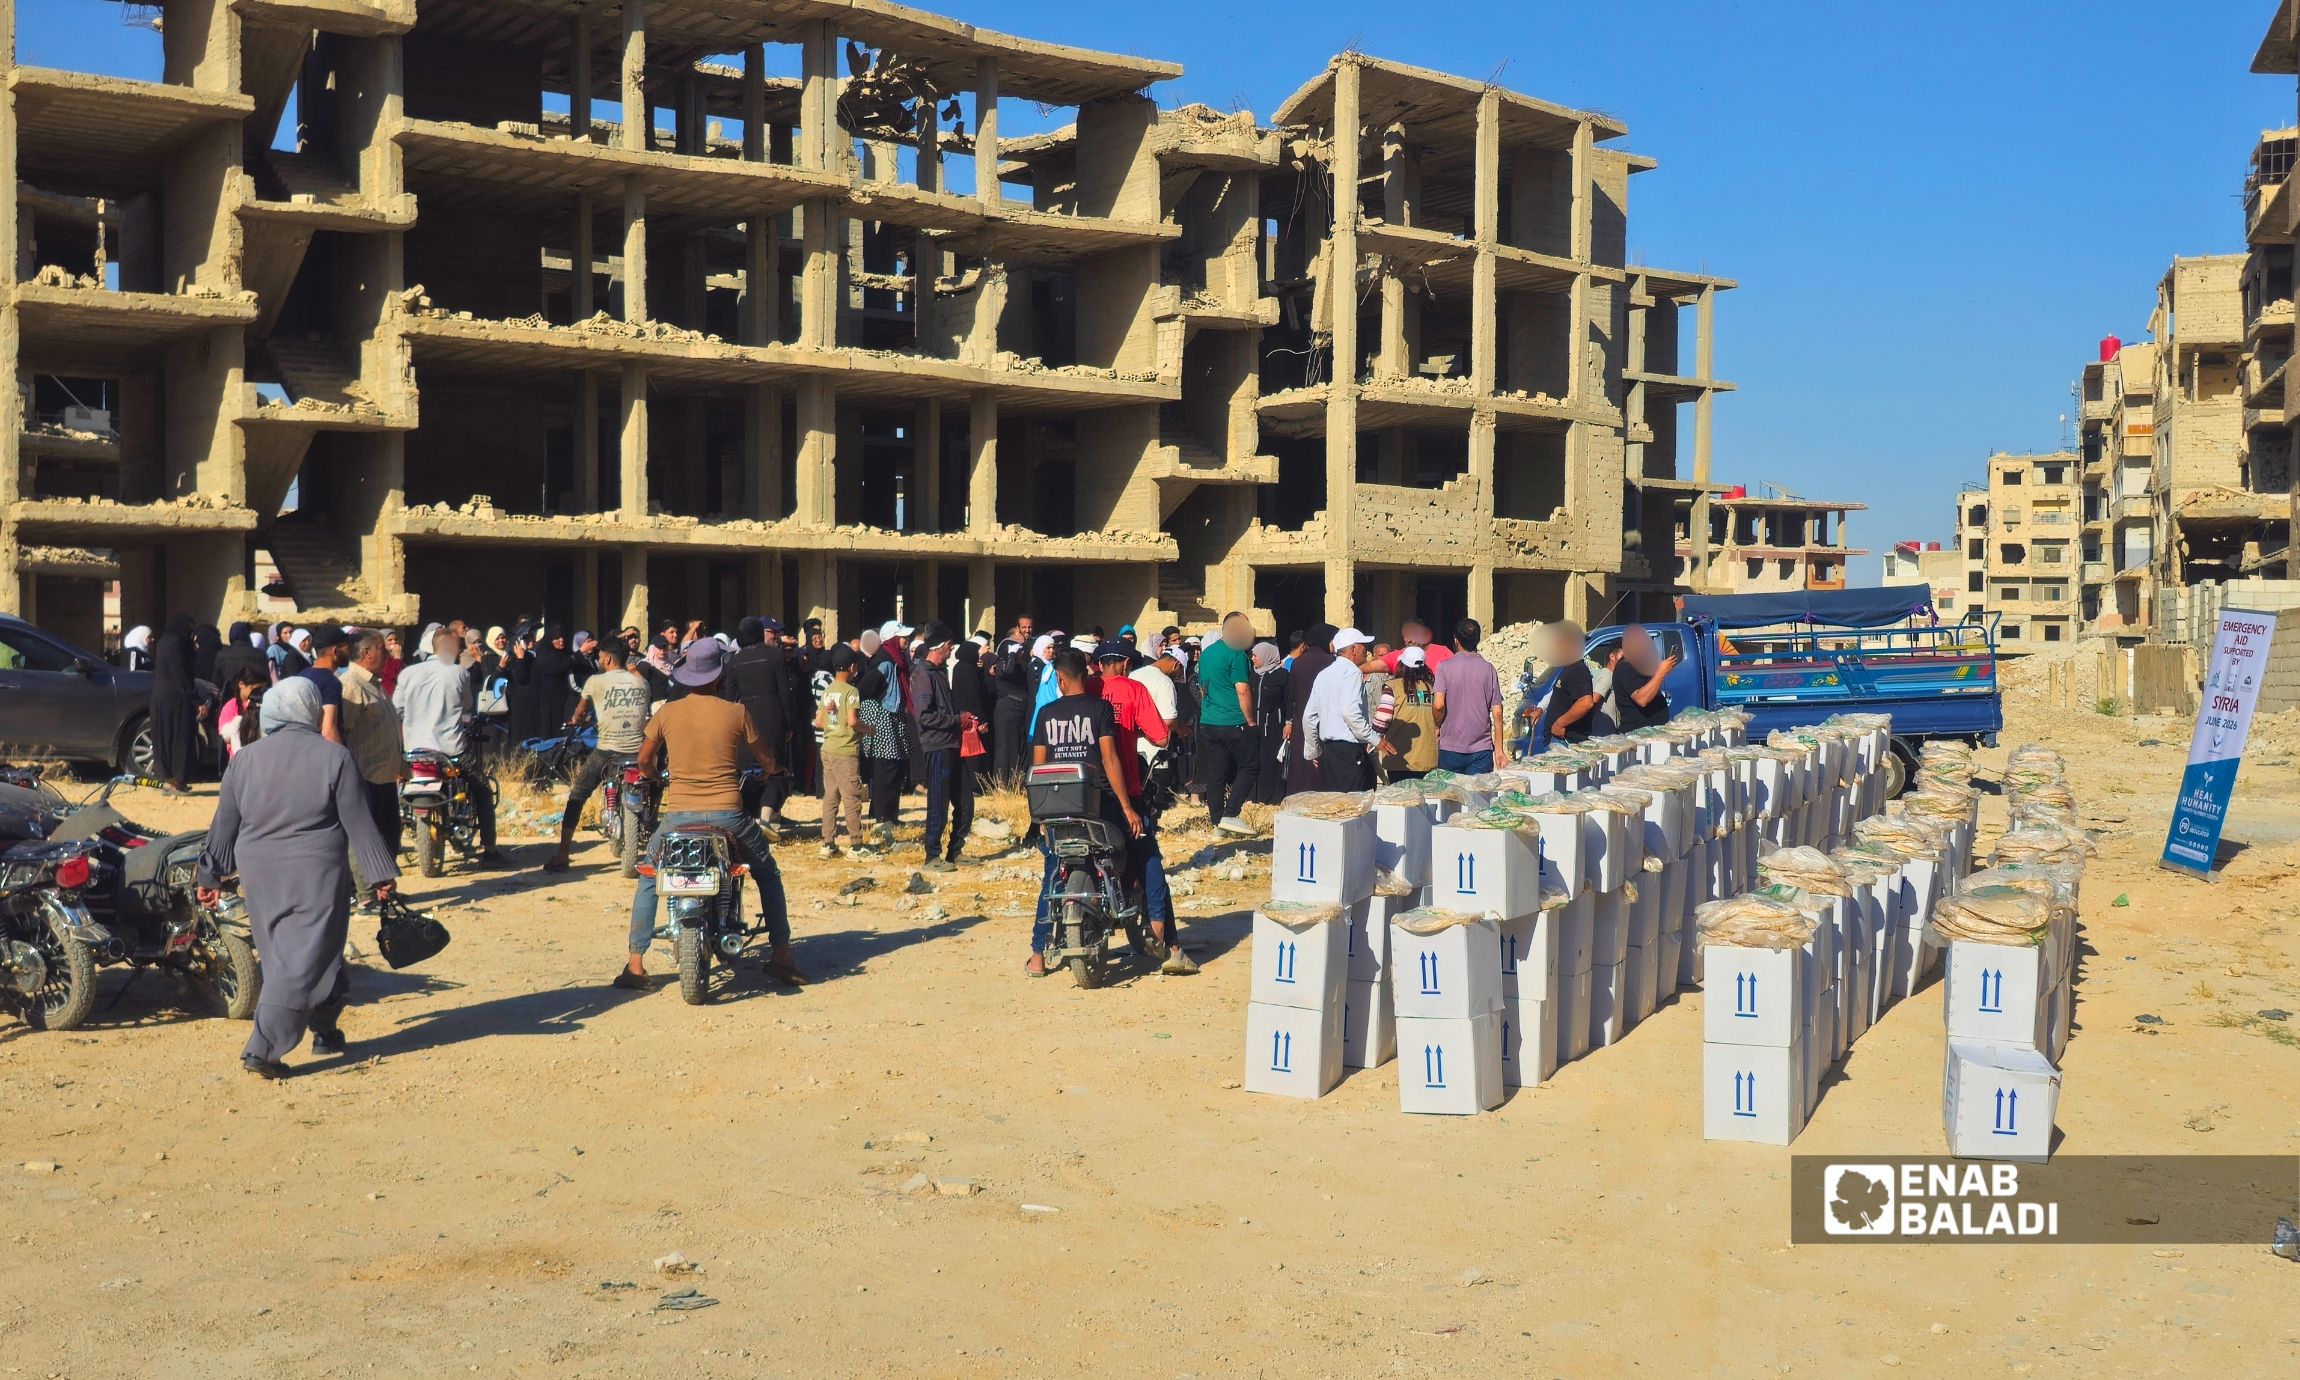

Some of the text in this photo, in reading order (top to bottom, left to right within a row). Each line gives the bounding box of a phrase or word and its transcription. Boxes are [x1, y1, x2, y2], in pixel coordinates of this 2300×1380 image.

[2222, 621, 2267, 635] EMERGENCY
[2234, 634, 2248, 645] AID
[2223, 646, 2254, 657] SUPPORTED
[604, 686, 646, 700] NEVER
[603, 697, 645, 711] ALONE
[2212, 695, 2239, 713] SYRIA
[1045, 714, 1095, 746] UTNA
[2205, 716, 2238, 730] JUNE 2026
[2193, 788, 2213, 802] HEAL
[2181, 796, 2222, 814] HUMANITY
